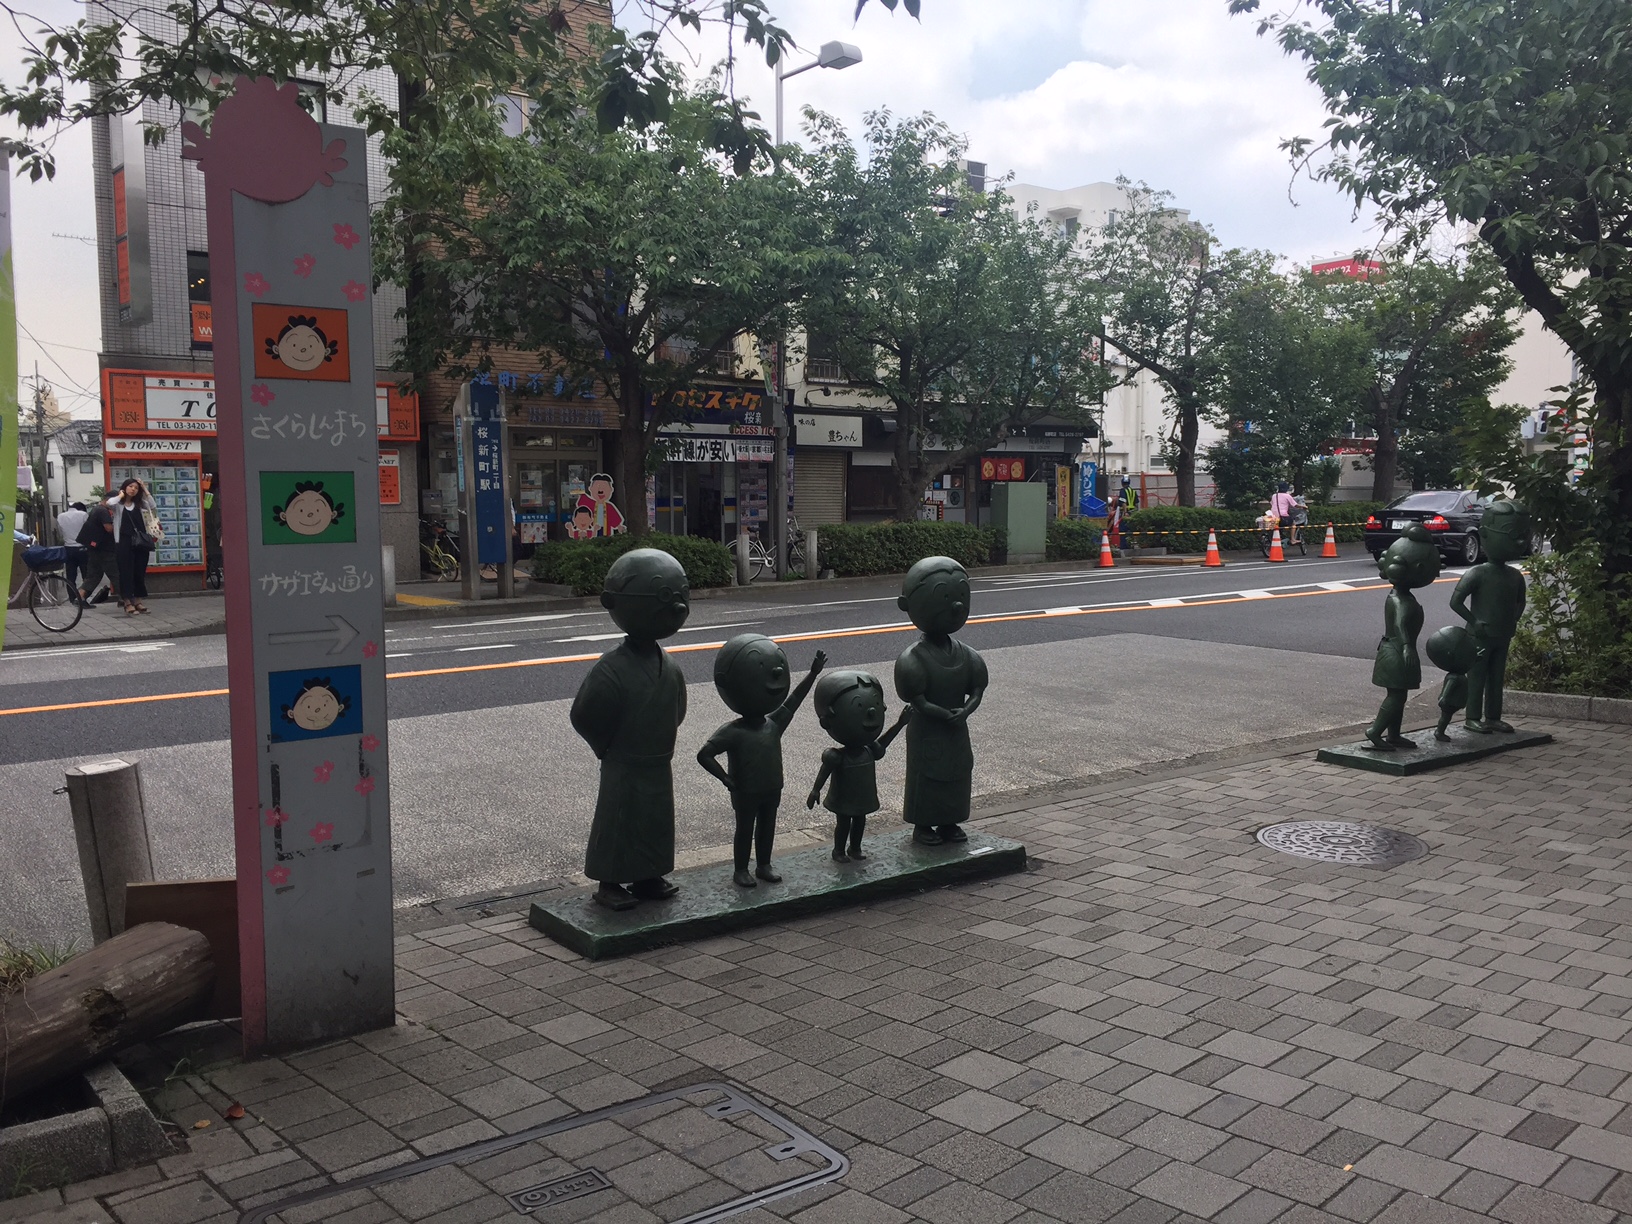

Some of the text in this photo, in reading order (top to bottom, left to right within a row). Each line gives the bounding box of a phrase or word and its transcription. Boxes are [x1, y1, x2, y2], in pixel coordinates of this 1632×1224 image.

[251, 409, 366, 446] さくらしんまち
[828, 430, 858, 442] 豊ちゃん
[130, 441, 191, 451] TOWN-NET
[477, 426, 491, 490] 桜新町駅
[258, 565, 374, 597] サザエさん通り
[550, 1177, 595, 1197] NTT
